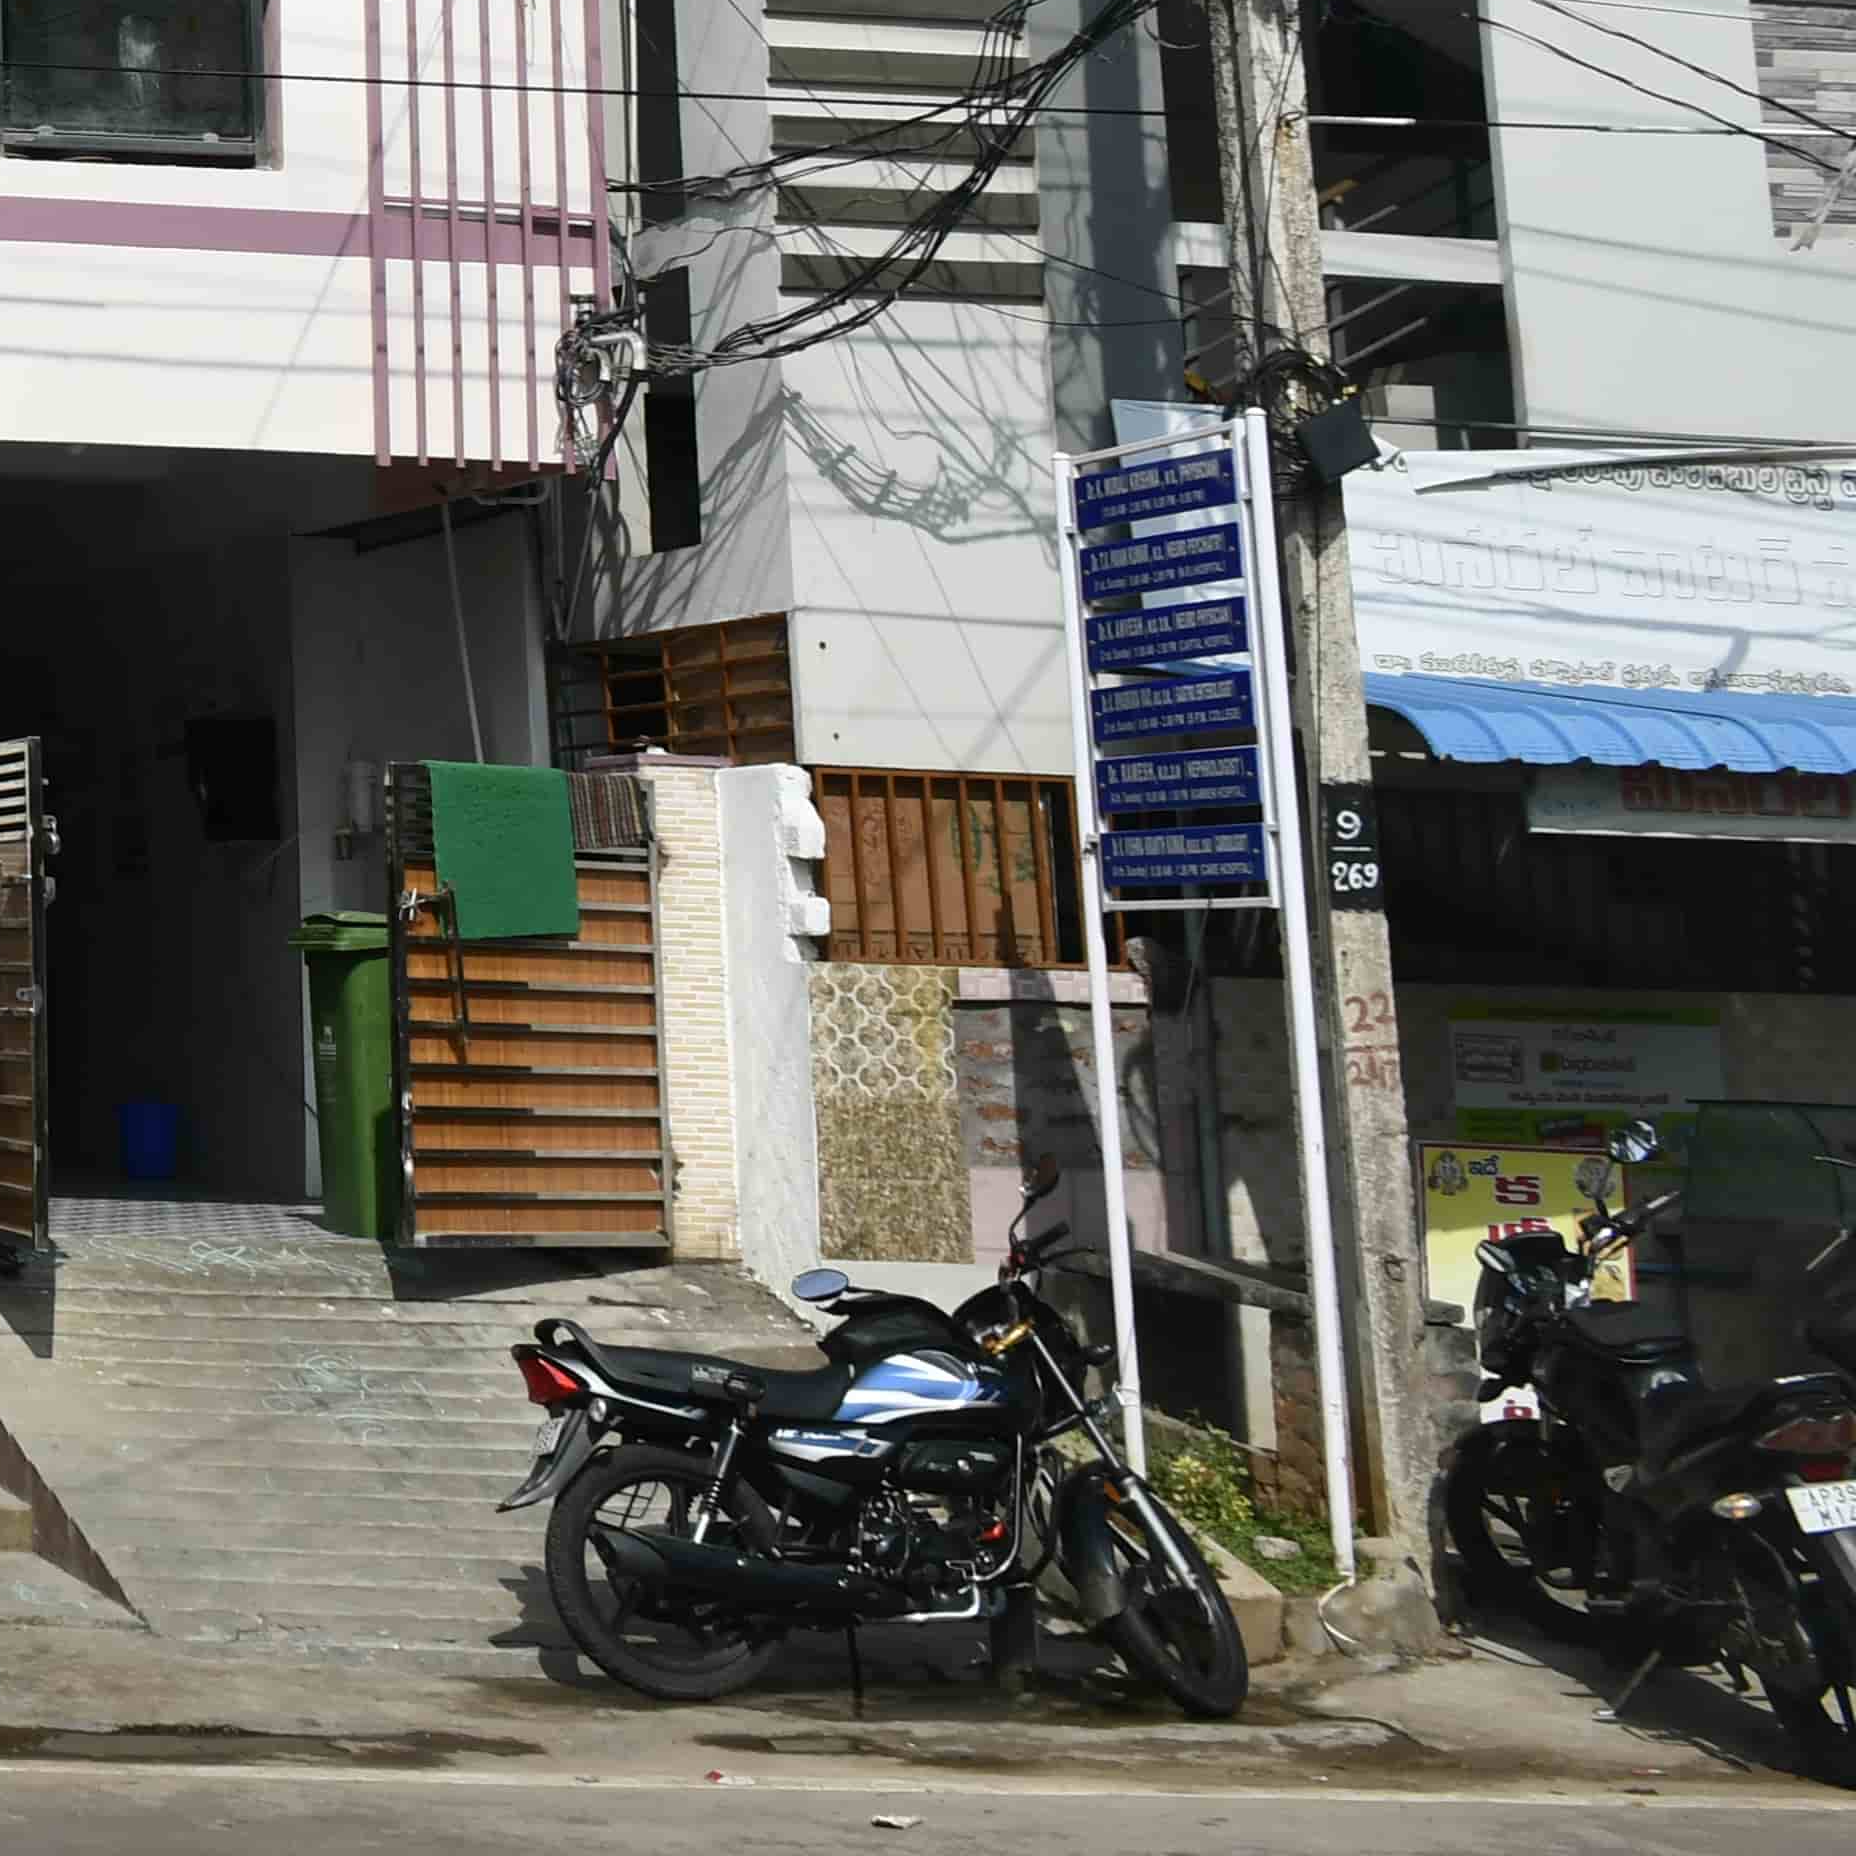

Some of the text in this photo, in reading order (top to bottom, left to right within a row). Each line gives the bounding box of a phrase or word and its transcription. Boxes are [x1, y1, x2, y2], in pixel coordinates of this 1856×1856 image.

[1335, 809, 1362, 840] 9
[1330, 861, 1379, 892] 269
[1344, 991, 1395, 1034] 22
